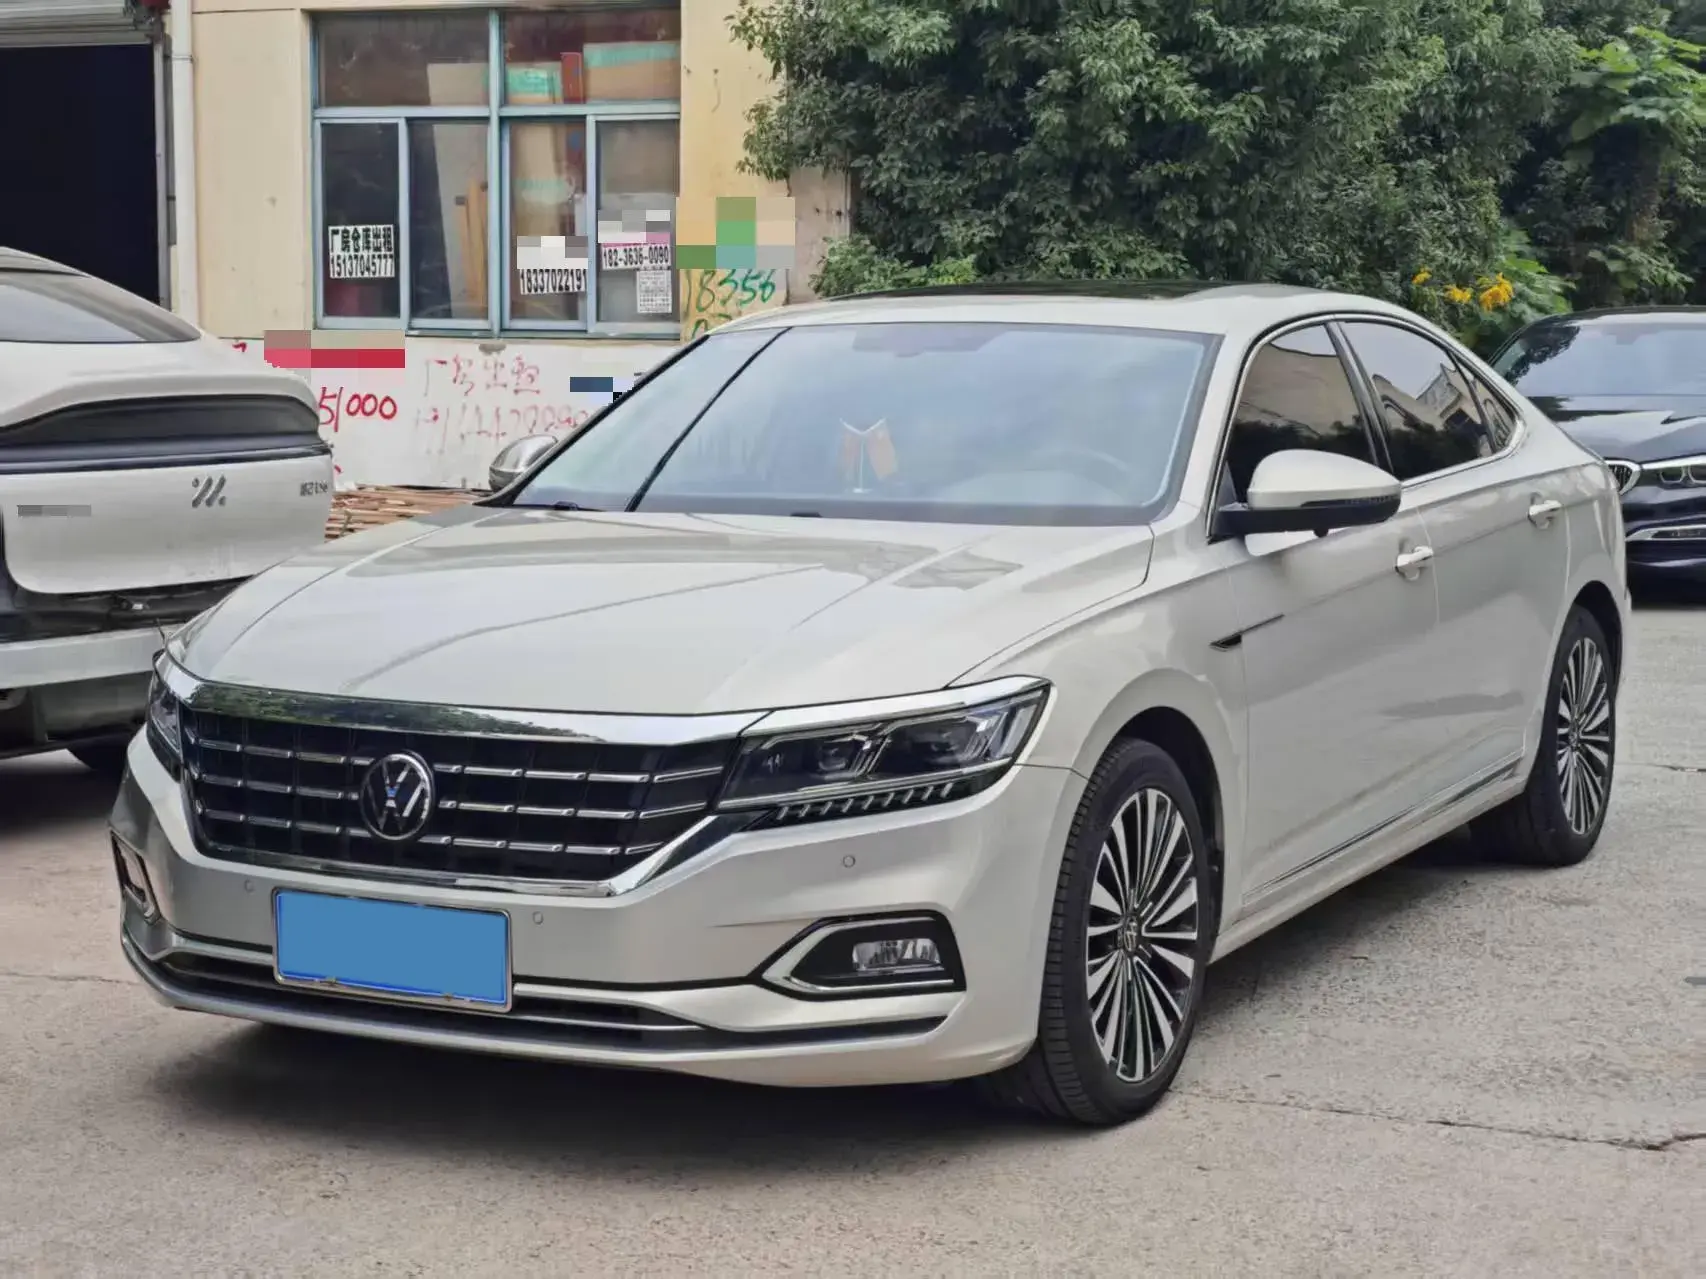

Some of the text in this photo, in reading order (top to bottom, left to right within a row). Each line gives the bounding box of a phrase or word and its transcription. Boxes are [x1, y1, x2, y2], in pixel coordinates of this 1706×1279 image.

[328, 226, 394, 253] 厂房仓库出租
[330, 253, 394, 277] 15137045777
[520, 268, 588, 293] 18337022191
